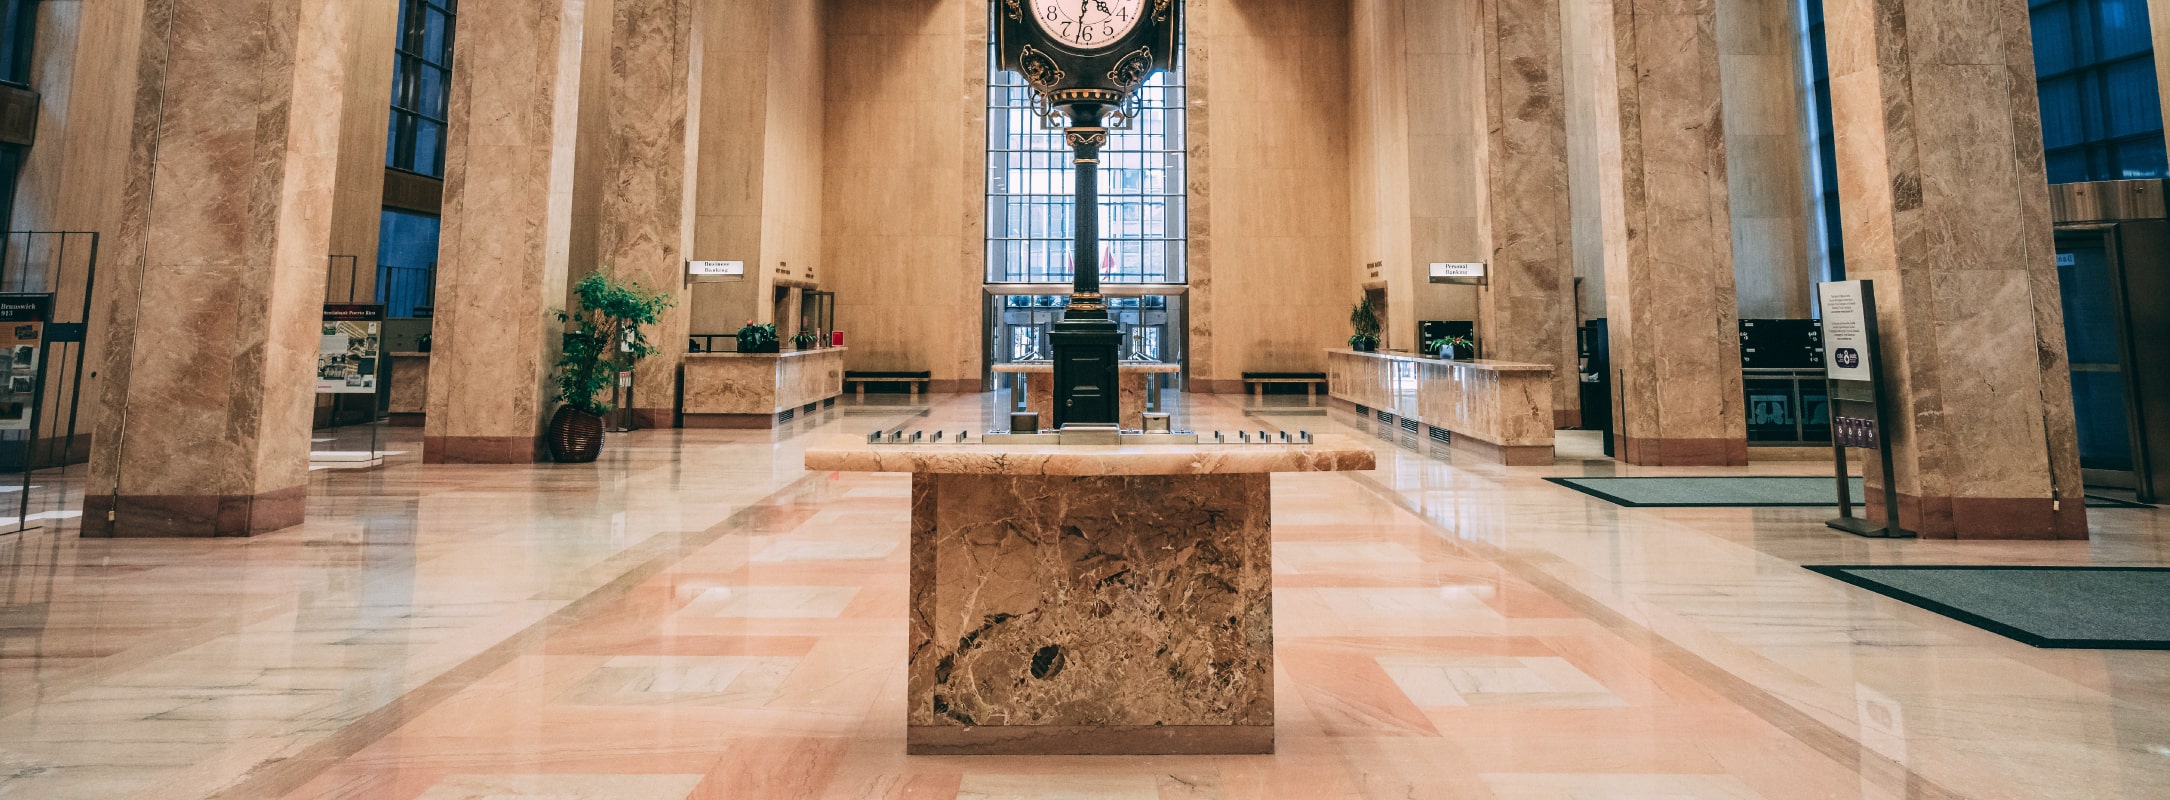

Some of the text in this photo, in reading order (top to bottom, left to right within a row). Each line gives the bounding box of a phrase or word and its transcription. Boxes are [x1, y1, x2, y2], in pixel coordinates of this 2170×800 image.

[1046, 5, 1058, 21] 8
[1116, 6, 1128, 22] 4
[1060, 21, 1072, 37] 7
[1082, 25, 1093, 42] 6
[1102, 20, 1114, 36] 5
